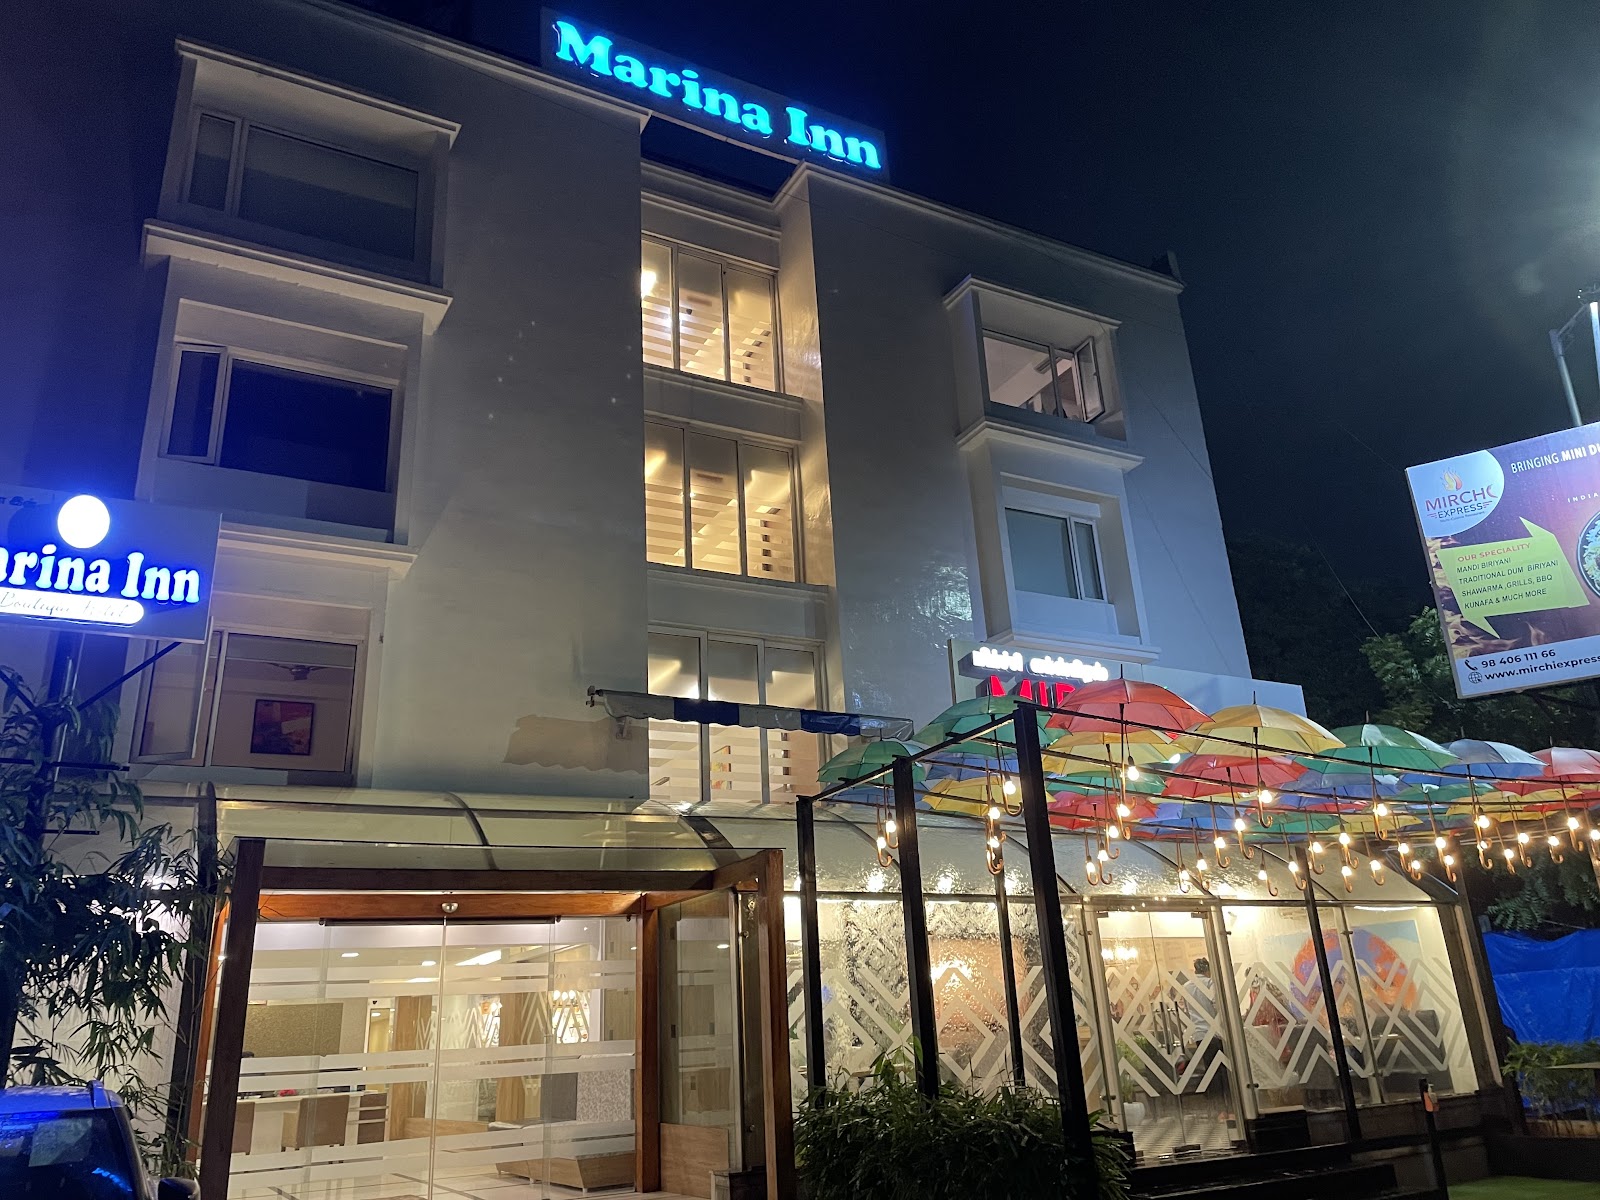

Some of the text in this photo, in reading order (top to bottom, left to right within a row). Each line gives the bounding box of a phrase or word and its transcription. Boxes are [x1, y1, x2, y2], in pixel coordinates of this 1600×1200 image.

[555, 20, 881, 169] Marina Inn
[1510, 452, 1560, 474] BRINGING
[1561, 446, 1587, 462] MINI
[1437, 502, 1483, 519] EXPRESS
[1457, 543, 1531, 563] OUR SPECIALITY
[1457, 557, 1512, 573] MANDI BIRIYANI
[1459, 560, 1559, 585] TRADITIONAL DUM BIRIYANI
[120, 551, 200, 603] Inn
[1536, 574, 1553, 583] BBQ
[1464, 598, 1494, 610] KUNAFA
[1502, 593, 1524, 603] MUCH
[1525, 588, 1547, 598] MORE
[1481, 648, 1556, 669] 98 406 111 66
